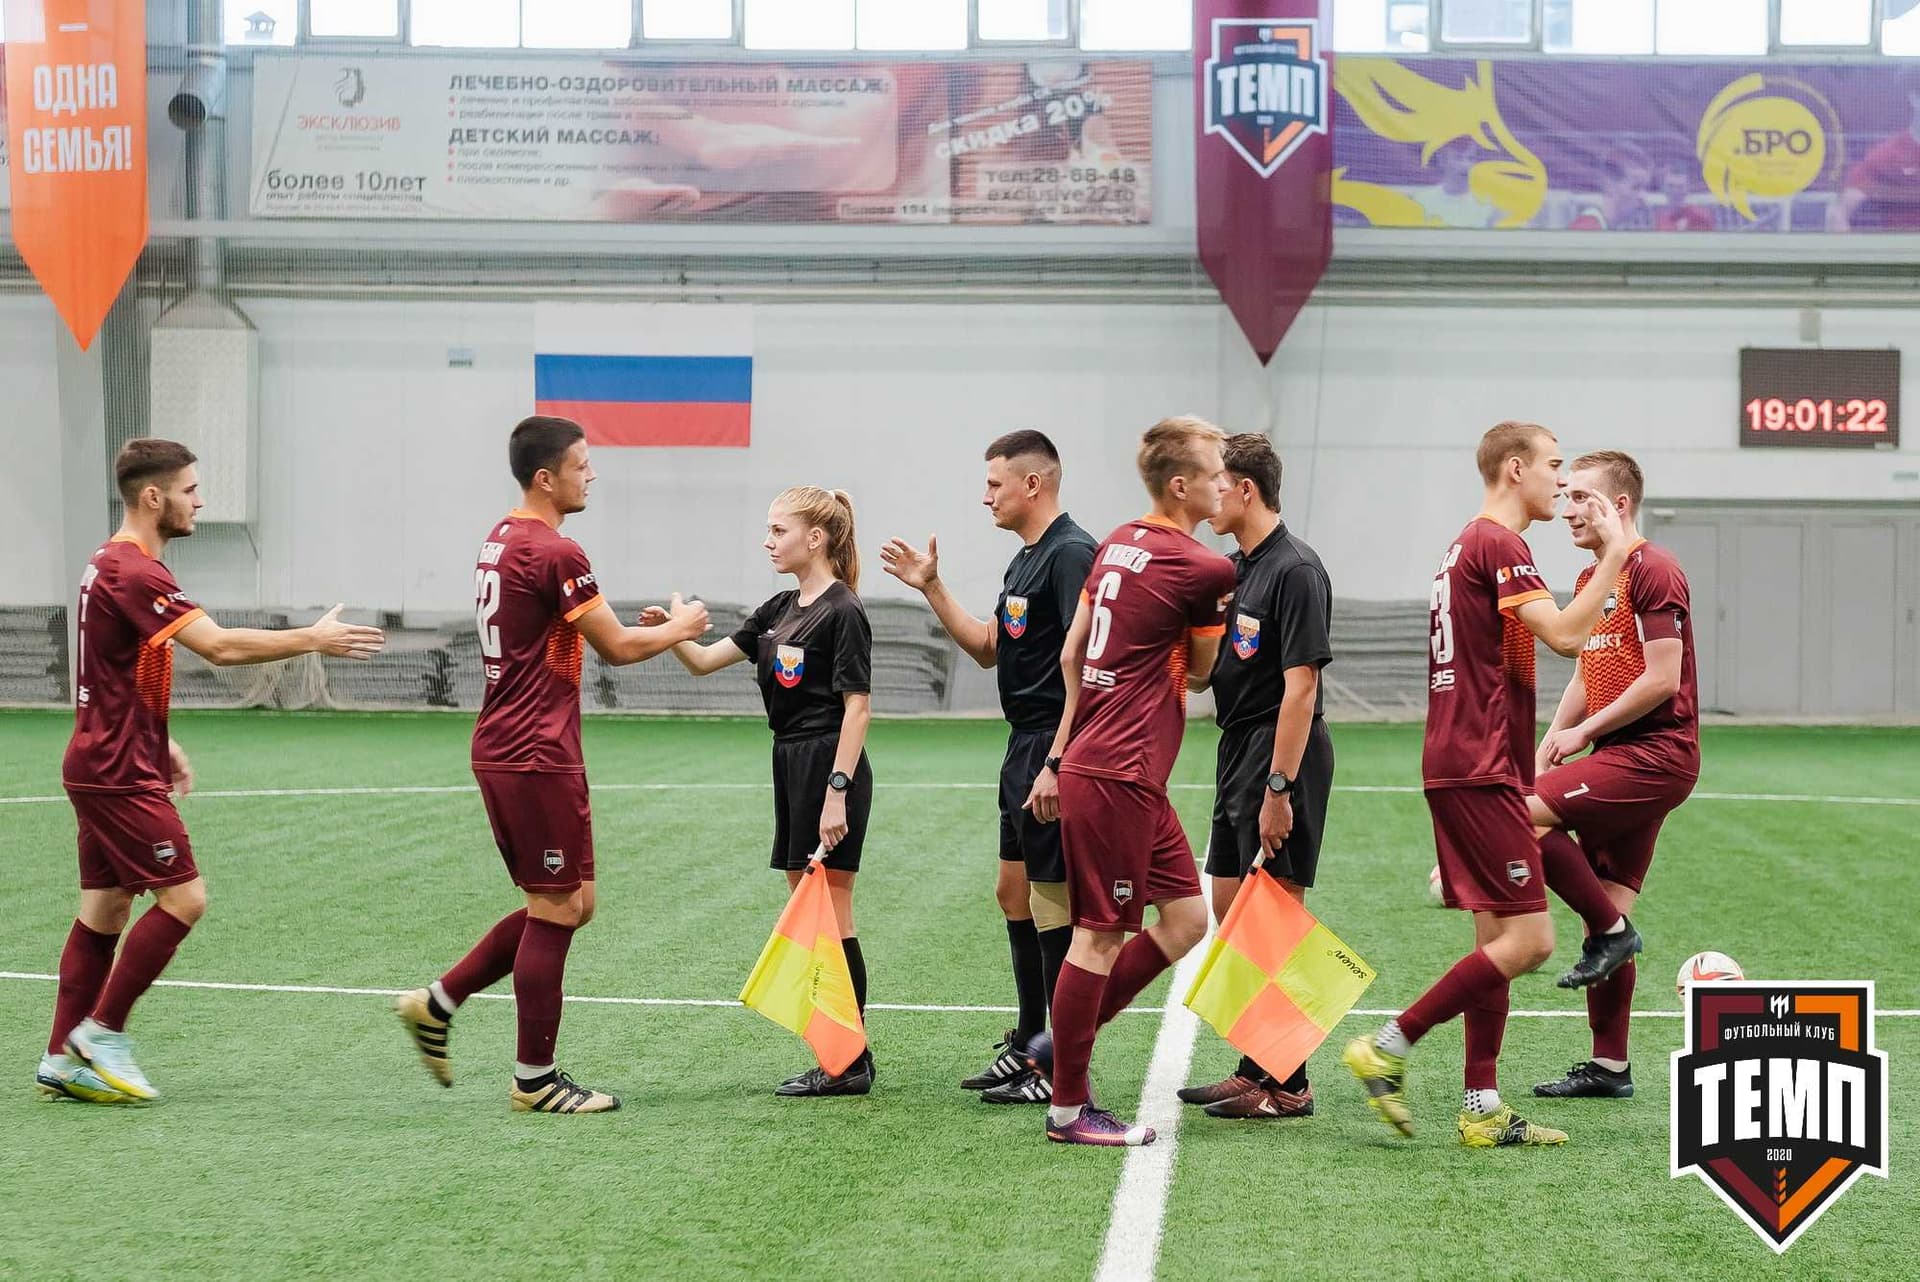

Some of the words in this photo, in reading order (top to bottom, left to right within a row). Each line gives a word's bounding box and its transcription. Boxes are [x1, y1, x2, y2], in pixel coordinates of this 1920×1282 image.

[34, 64, 117, 117] ОДНА
[450, 75, 778, 94] ЛЕЧЕБНО-ОЗДОРОВИТЕЛЬНЫЙ
[1216, 63, 1315, 117] ТЕМП
[297, 115, 401, 131] ЭКСКЛЮЗИВ
[449, 126, 549, 144] ДЕТСКИЙ
[935, 114, 1040, 159] скидка
[1045, 89, 1112, 126] 20%
[24, 126, 132, 173] СЕМЬЯ!
[268, 169, 345, 190] более
[1746, 398, 1888, 432] 19:01:22
[1086, 571, 1122, 660] 6
